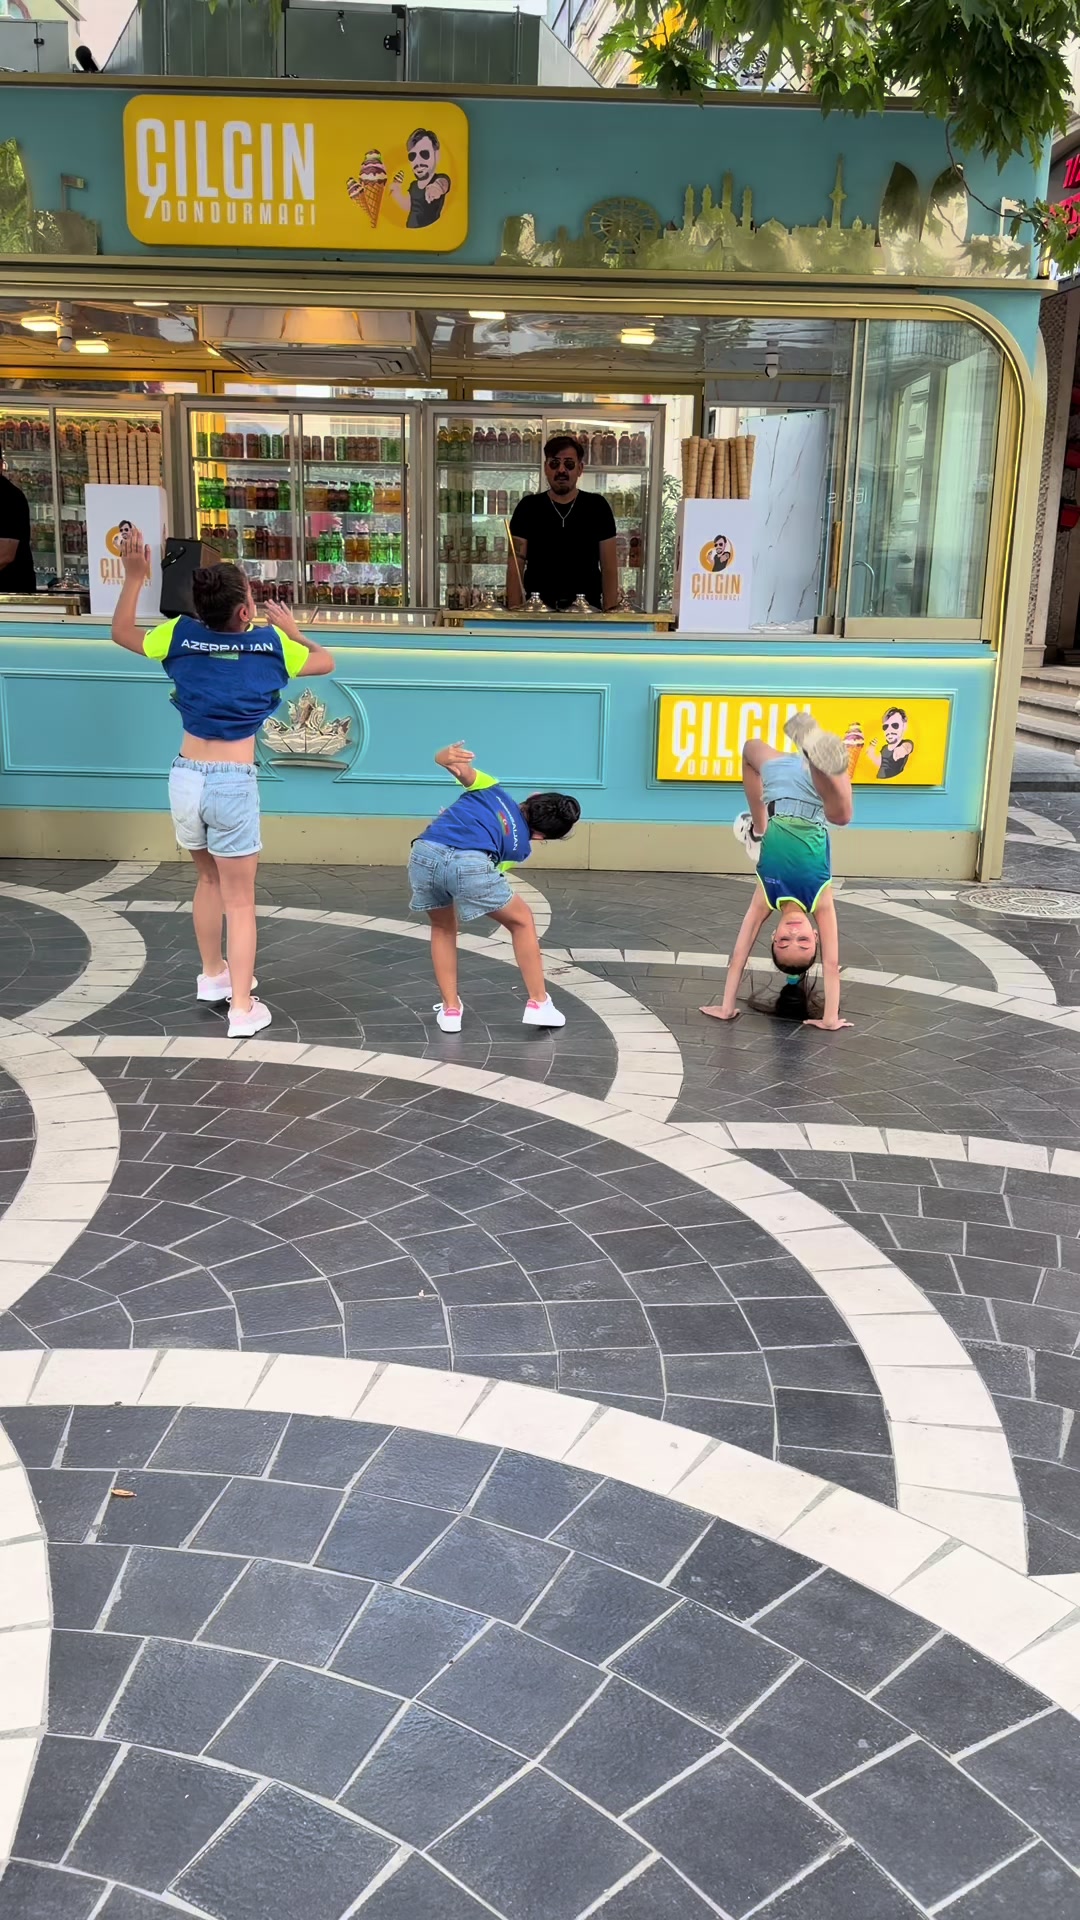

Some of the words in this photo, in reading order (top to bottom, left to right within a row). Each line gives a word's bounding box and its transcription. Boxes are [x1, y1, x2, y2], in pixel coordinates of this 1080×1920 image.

[136, 118, 316, 219] ÇILGIN
[100, 557, 152, 584] ÇIL
[691, 573, 741, 600] ÇILGIN
